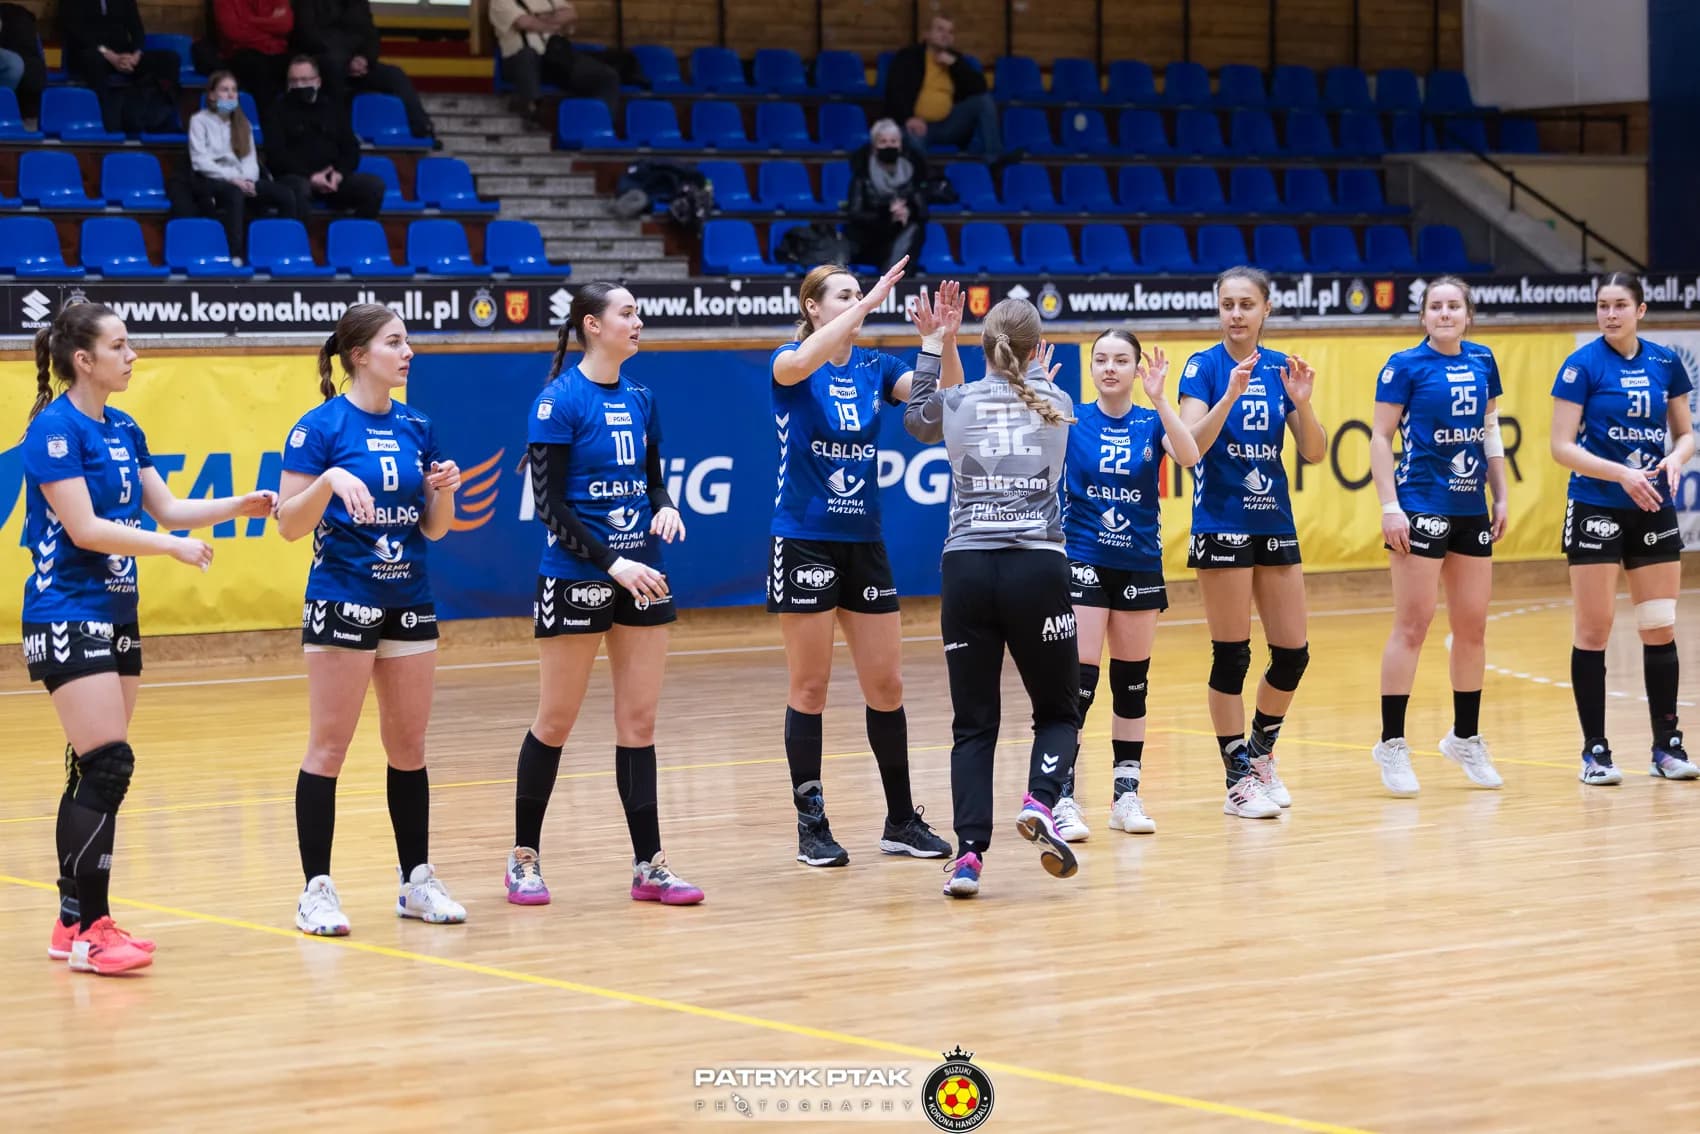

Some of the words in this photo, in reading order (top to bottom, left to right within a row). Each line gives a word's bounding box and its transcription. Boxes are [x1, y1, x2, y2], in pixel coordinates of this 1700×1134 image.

[1451, 385, 1478, 416] 25
[1626, 390, 1651, 418] 31
[834, 401, 861, 431] 19
[1242, 400, 1269, 431] 23
[976, 402, 1042, 458] 32
[611, 430, 636, 466] 10
[1099, 444, 1131, 476] 22
[379, 456, 399, 491] 8
[119, 466, 132, 504] 5
[827, 506, 866, 515] MAZURY
[828, 498, 865, 507] WARMIA
[1416, 516, 1449, 534] MOP
[1586, 519, 1620, 534] MOP
[609, 531, 645, 542] WARMIA
[1098, 532, 1133, 542] WARMIA
[371, 562, 412, 571] WARMIA
[1211, 554, 1236, 562] hummel
[371, 570, 411, 580] MAZURY
[797, 569, 836, 585] MOP
[571, 587, 613, 603] MOP
[342, 602, 383, 622] MOP
[563, 617, 591, 625] hummel
[1042, 613, 1076, 635] AMH
[333, 630, 362, 641] hummel
